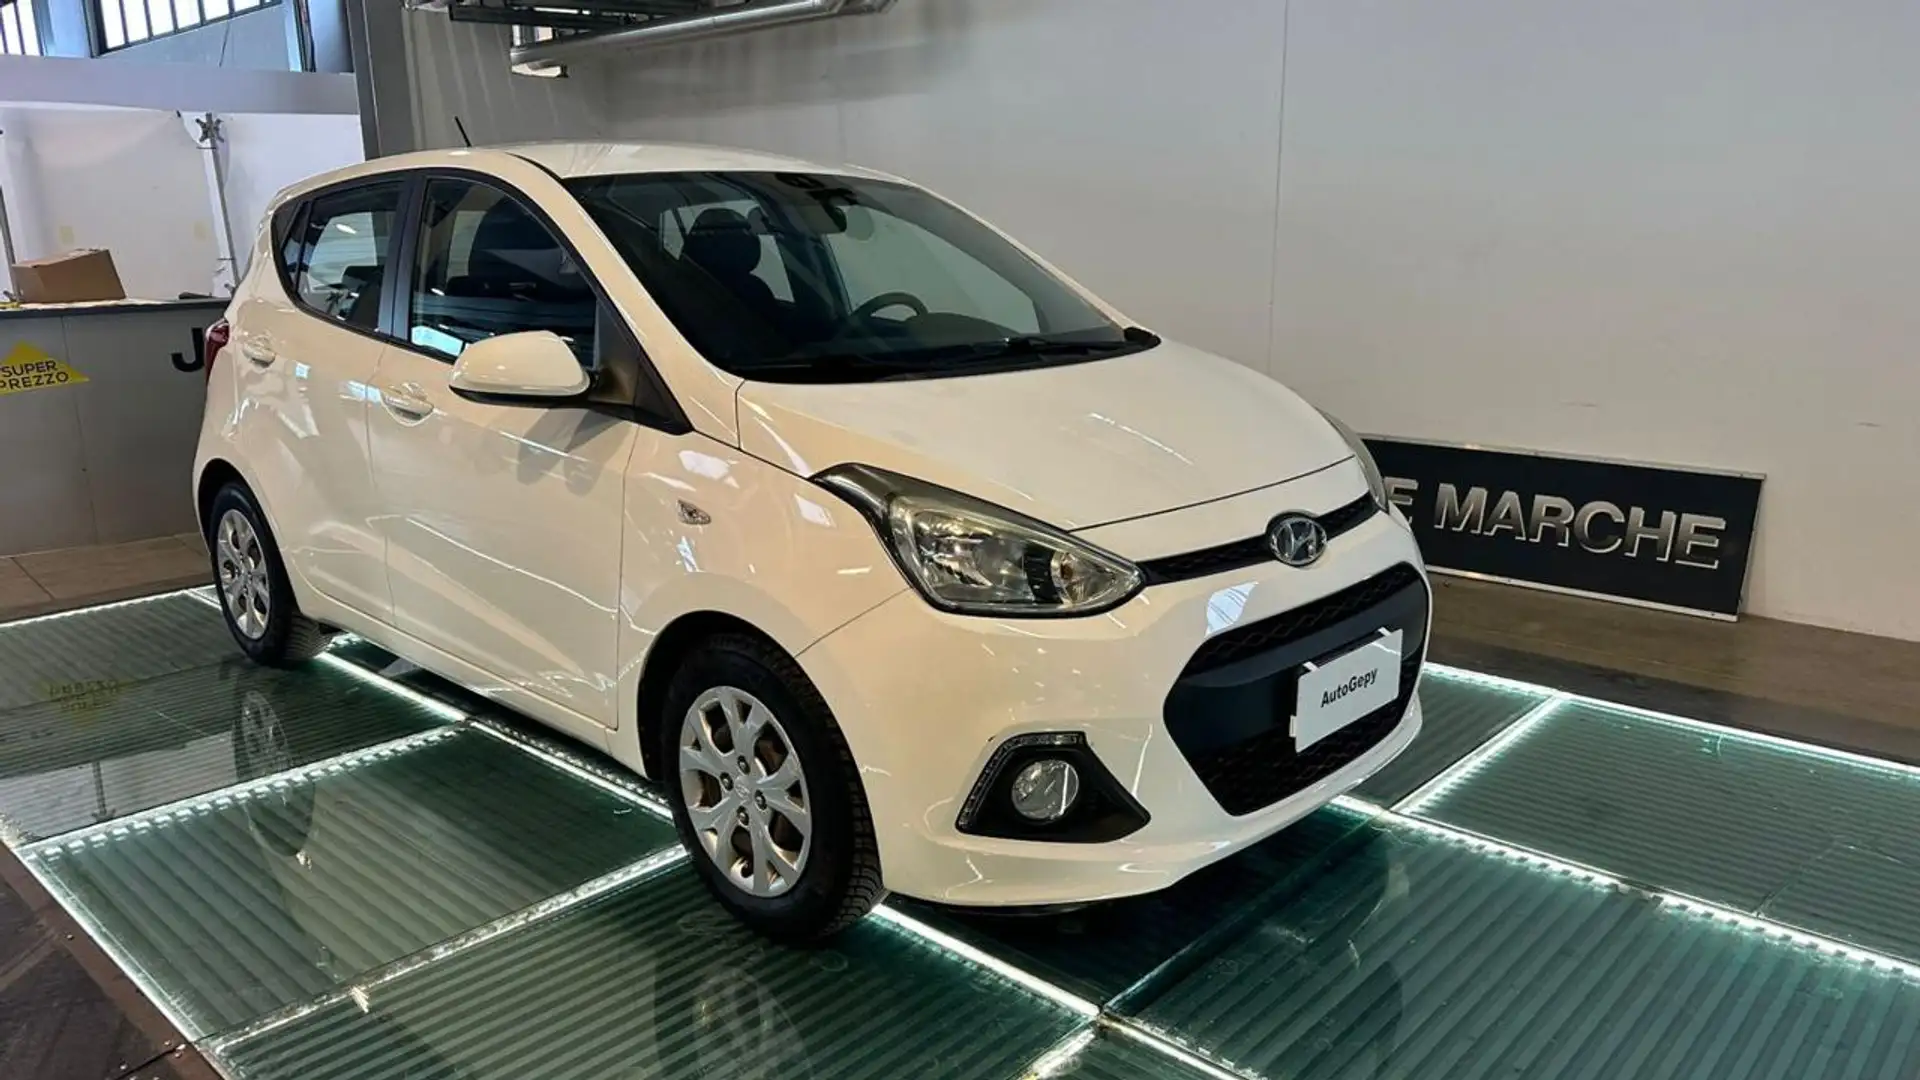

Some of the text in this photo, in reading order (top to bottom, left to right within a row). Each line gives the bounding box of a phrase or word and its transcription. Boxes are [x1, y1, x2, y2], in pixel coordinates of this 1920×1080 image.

[0, 371, 69, 390] PREZZO
[1, 360, 58, 378] SUPER
[1434, 482, 1727, 570] MARCHE
[1320, 668, 1378, 708] AutoGepy
